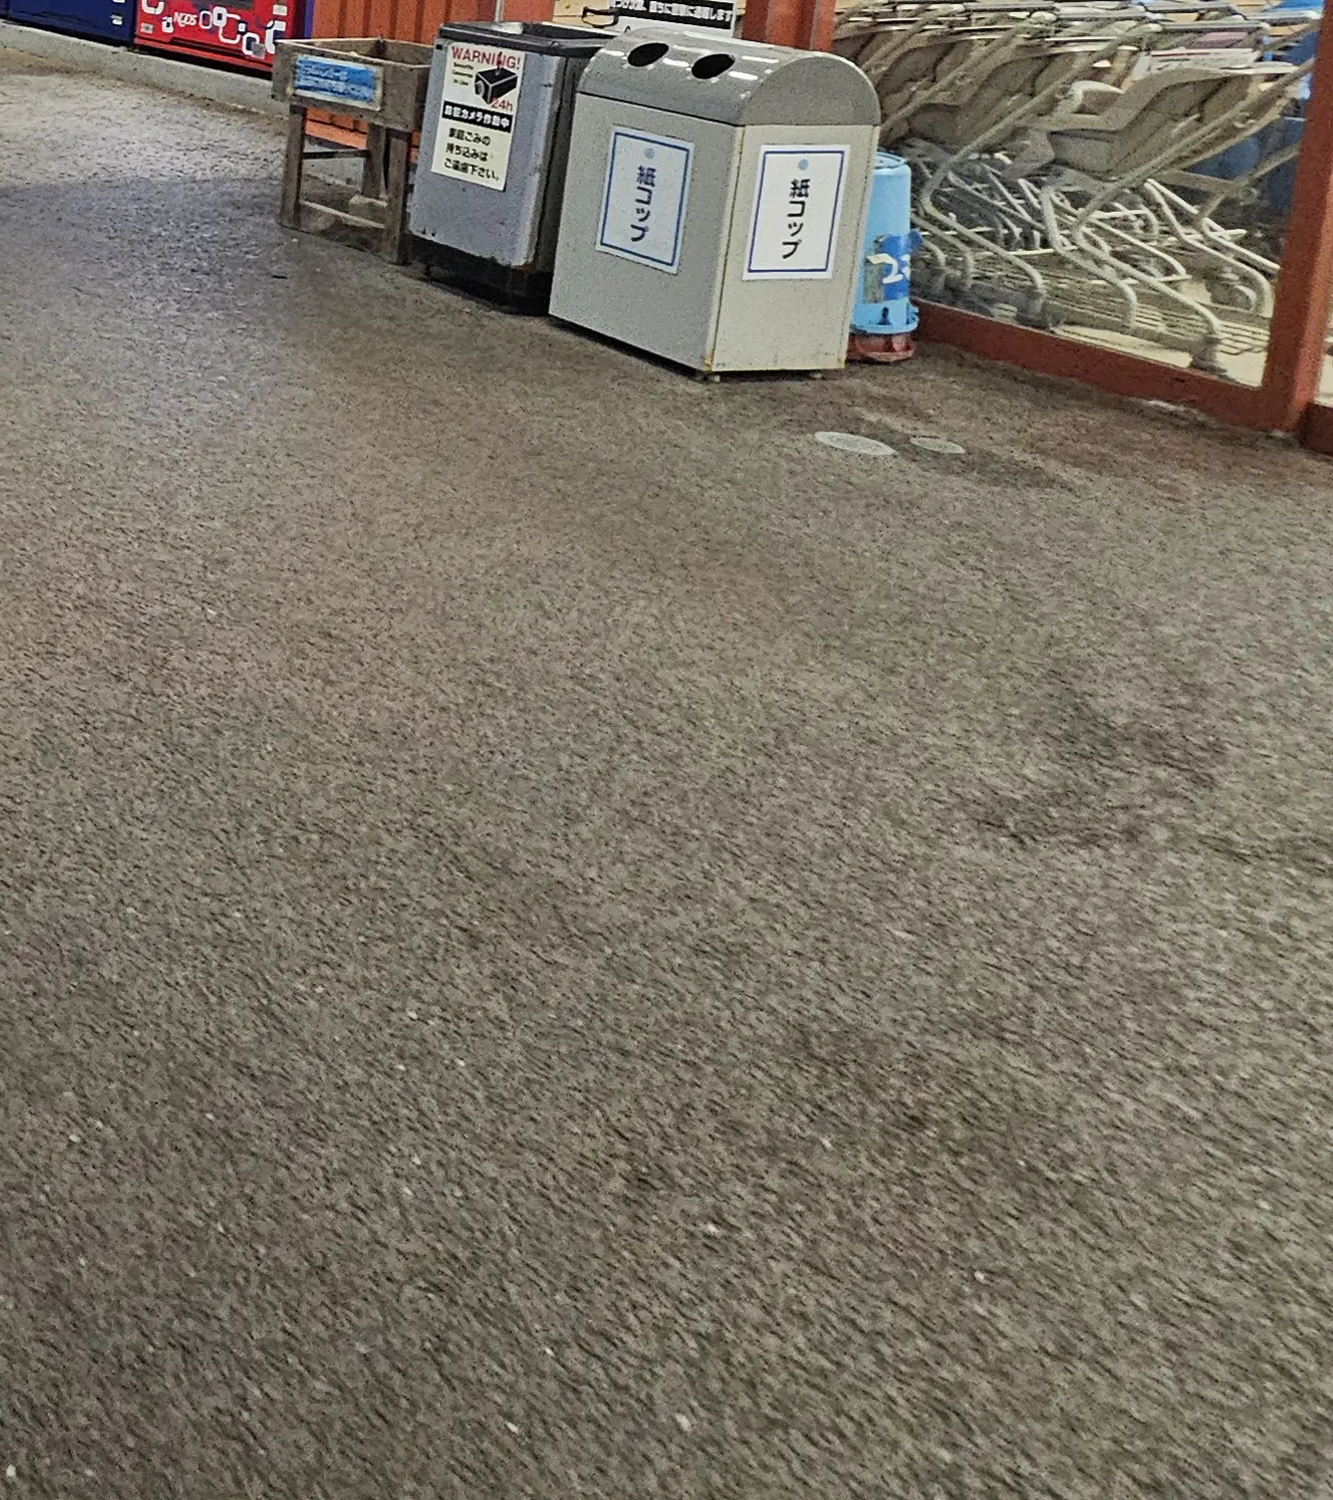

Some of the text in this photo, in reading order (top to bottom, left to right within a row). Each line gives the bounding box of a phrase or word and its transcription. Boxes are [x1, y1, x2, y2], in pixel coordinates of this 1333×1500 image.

[451, 47, 521, 70] WARNING!
[490, 97, 513, 112] 24h
[449, 127, 491, 146] 家庭ごみの
[445, 143, 488, 162] 持ち込みは
[630, 164, 657, 242] 紙コップ
[782, 178, 811, 260] 紙コップ
